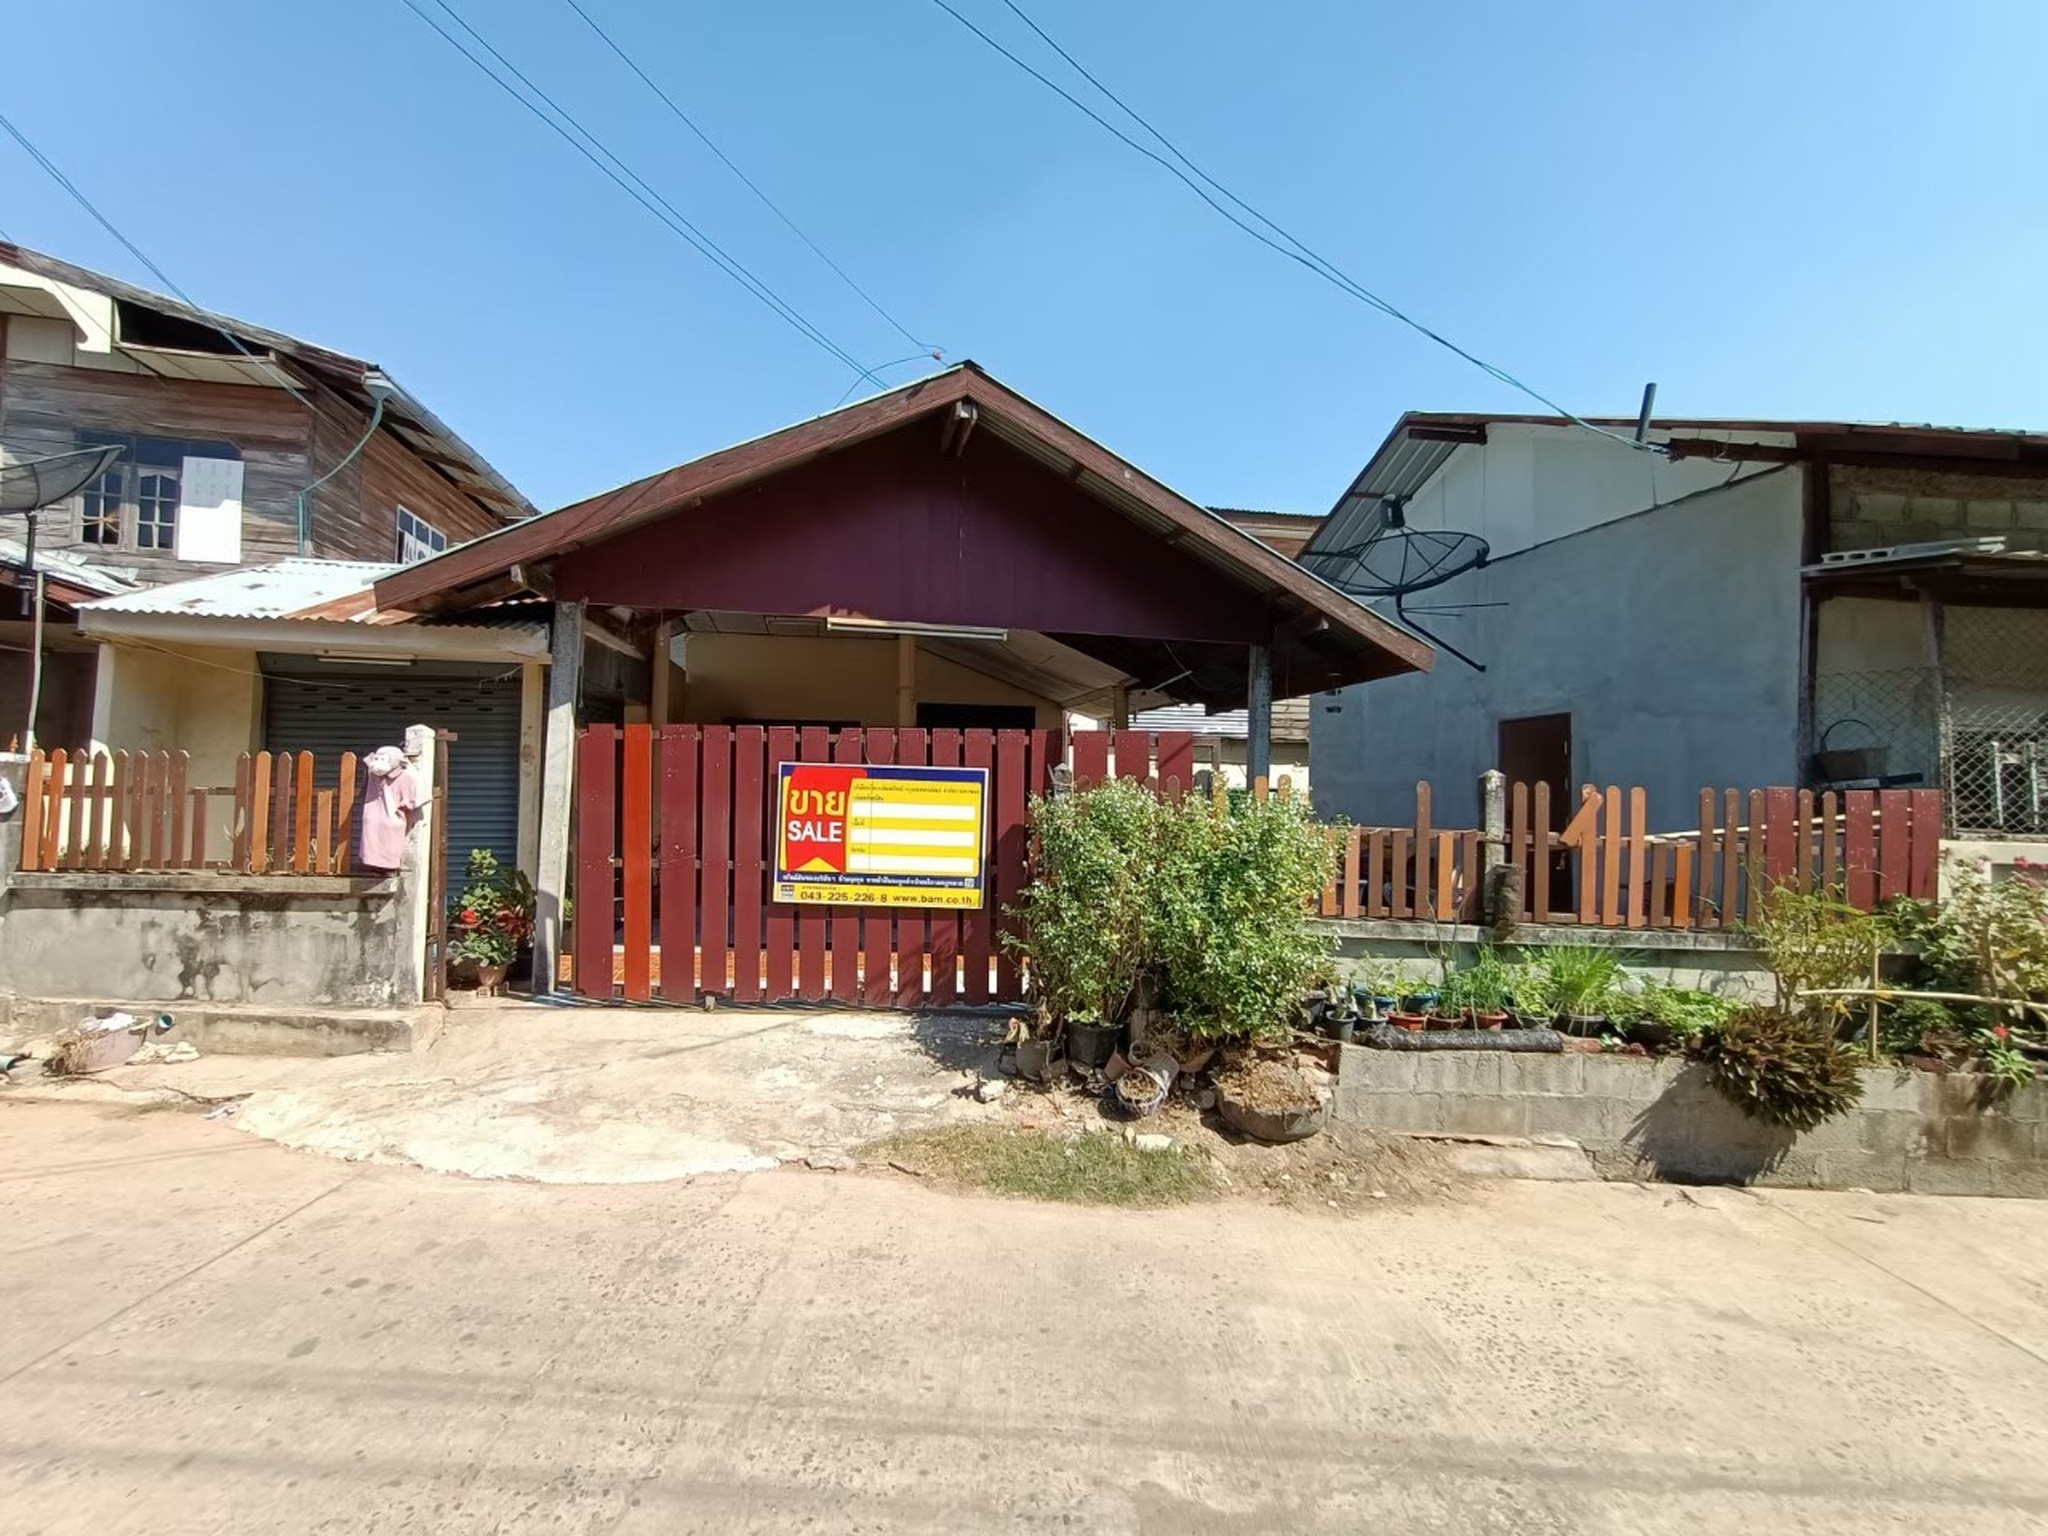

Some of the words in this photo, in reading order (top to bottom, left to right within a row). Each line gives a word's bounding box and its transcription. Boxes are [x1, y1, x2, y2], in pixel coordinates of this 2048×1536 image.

[789, 789, 846, 816] ขาย
[787, 820, 843, 843] SALE
[893, 894, 973, 905] www.bam.co.th
